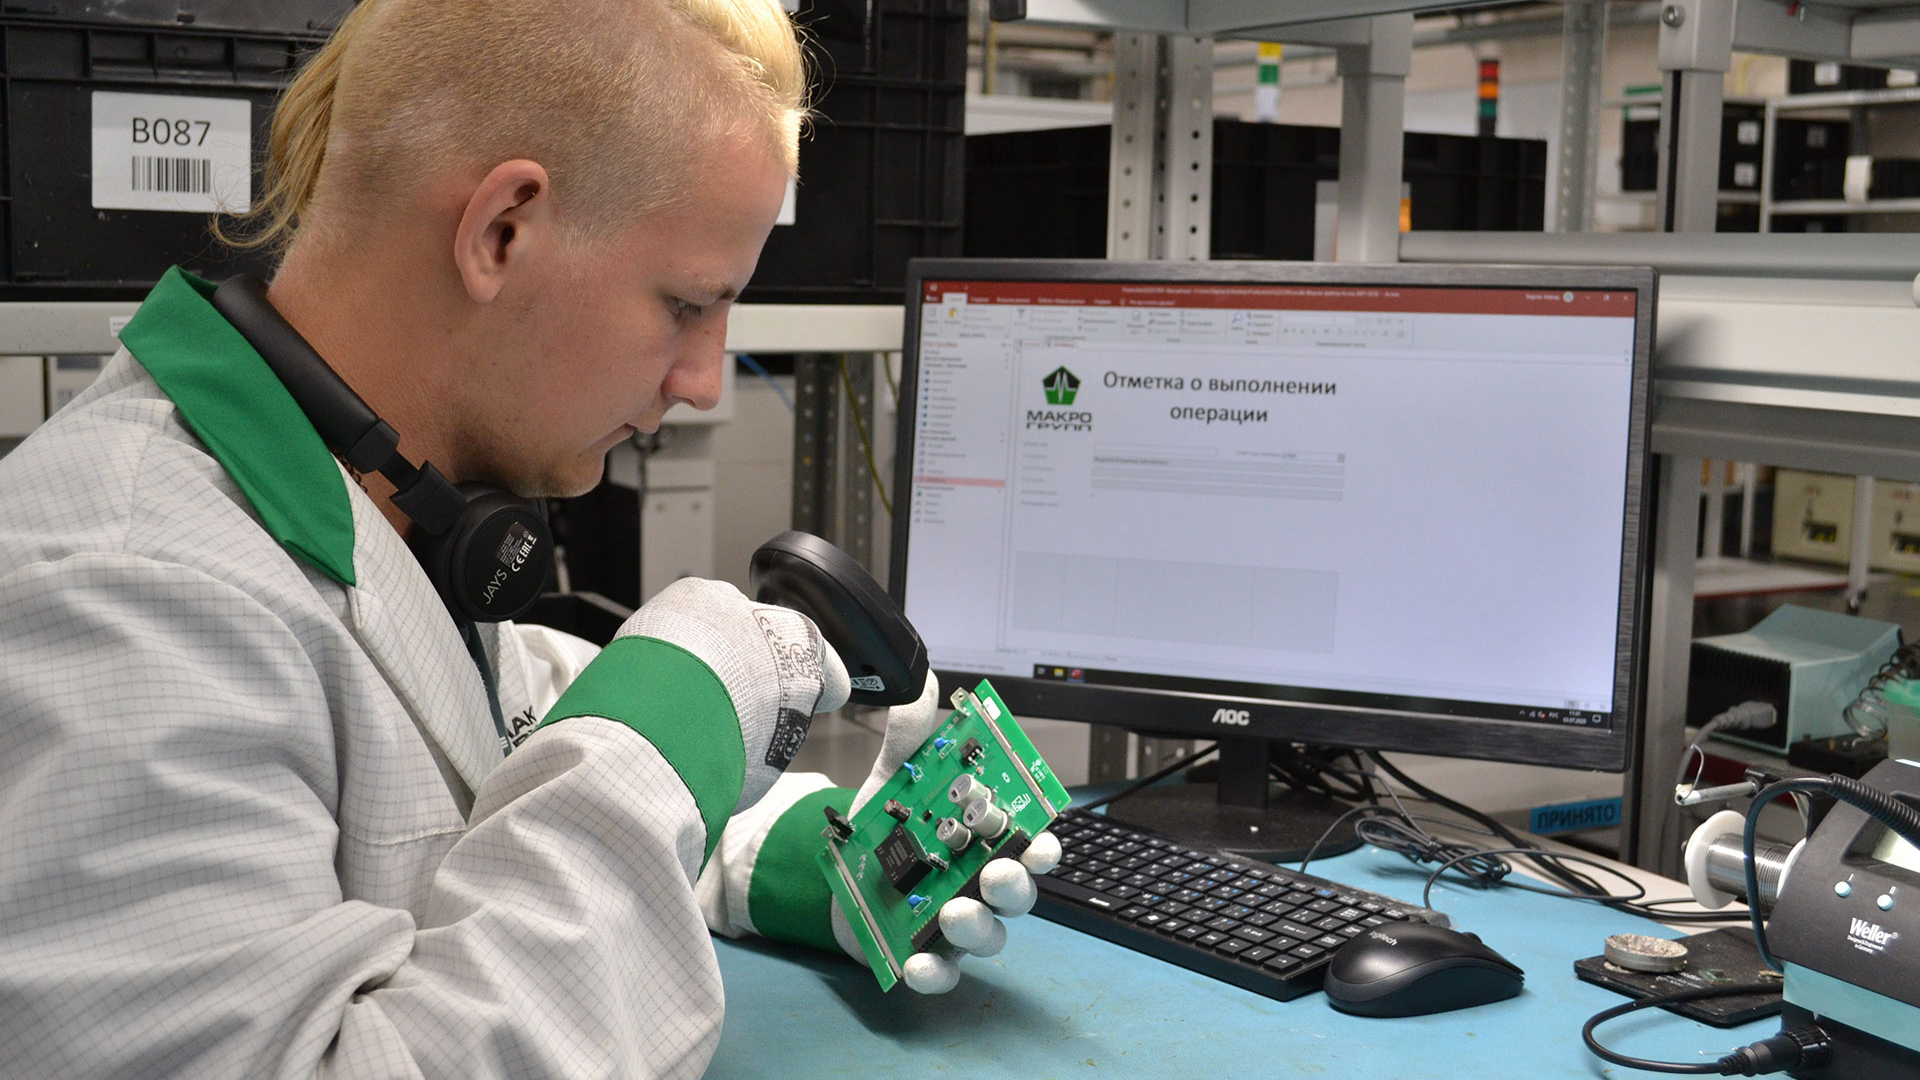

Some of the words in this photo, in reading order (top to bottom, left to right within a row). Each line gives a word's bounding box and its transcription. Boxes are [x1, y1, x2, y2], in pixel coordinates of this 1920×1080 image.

[132, 117, 211, 147] B087
[1103, 370, 1184, 391] Отметка
[1190, 377, 1203, 391] о
[1208, 378, 1338, 395] выполнении
[1026, 410, 1093, 424] МАКРО
[1169, 405, 1268, 425] операции
[482, 569, 507, 604] JAYS
[1211, 708, 1250, 727] AOC
[1537, 803, 1616, 829] ПРИНЯТО
